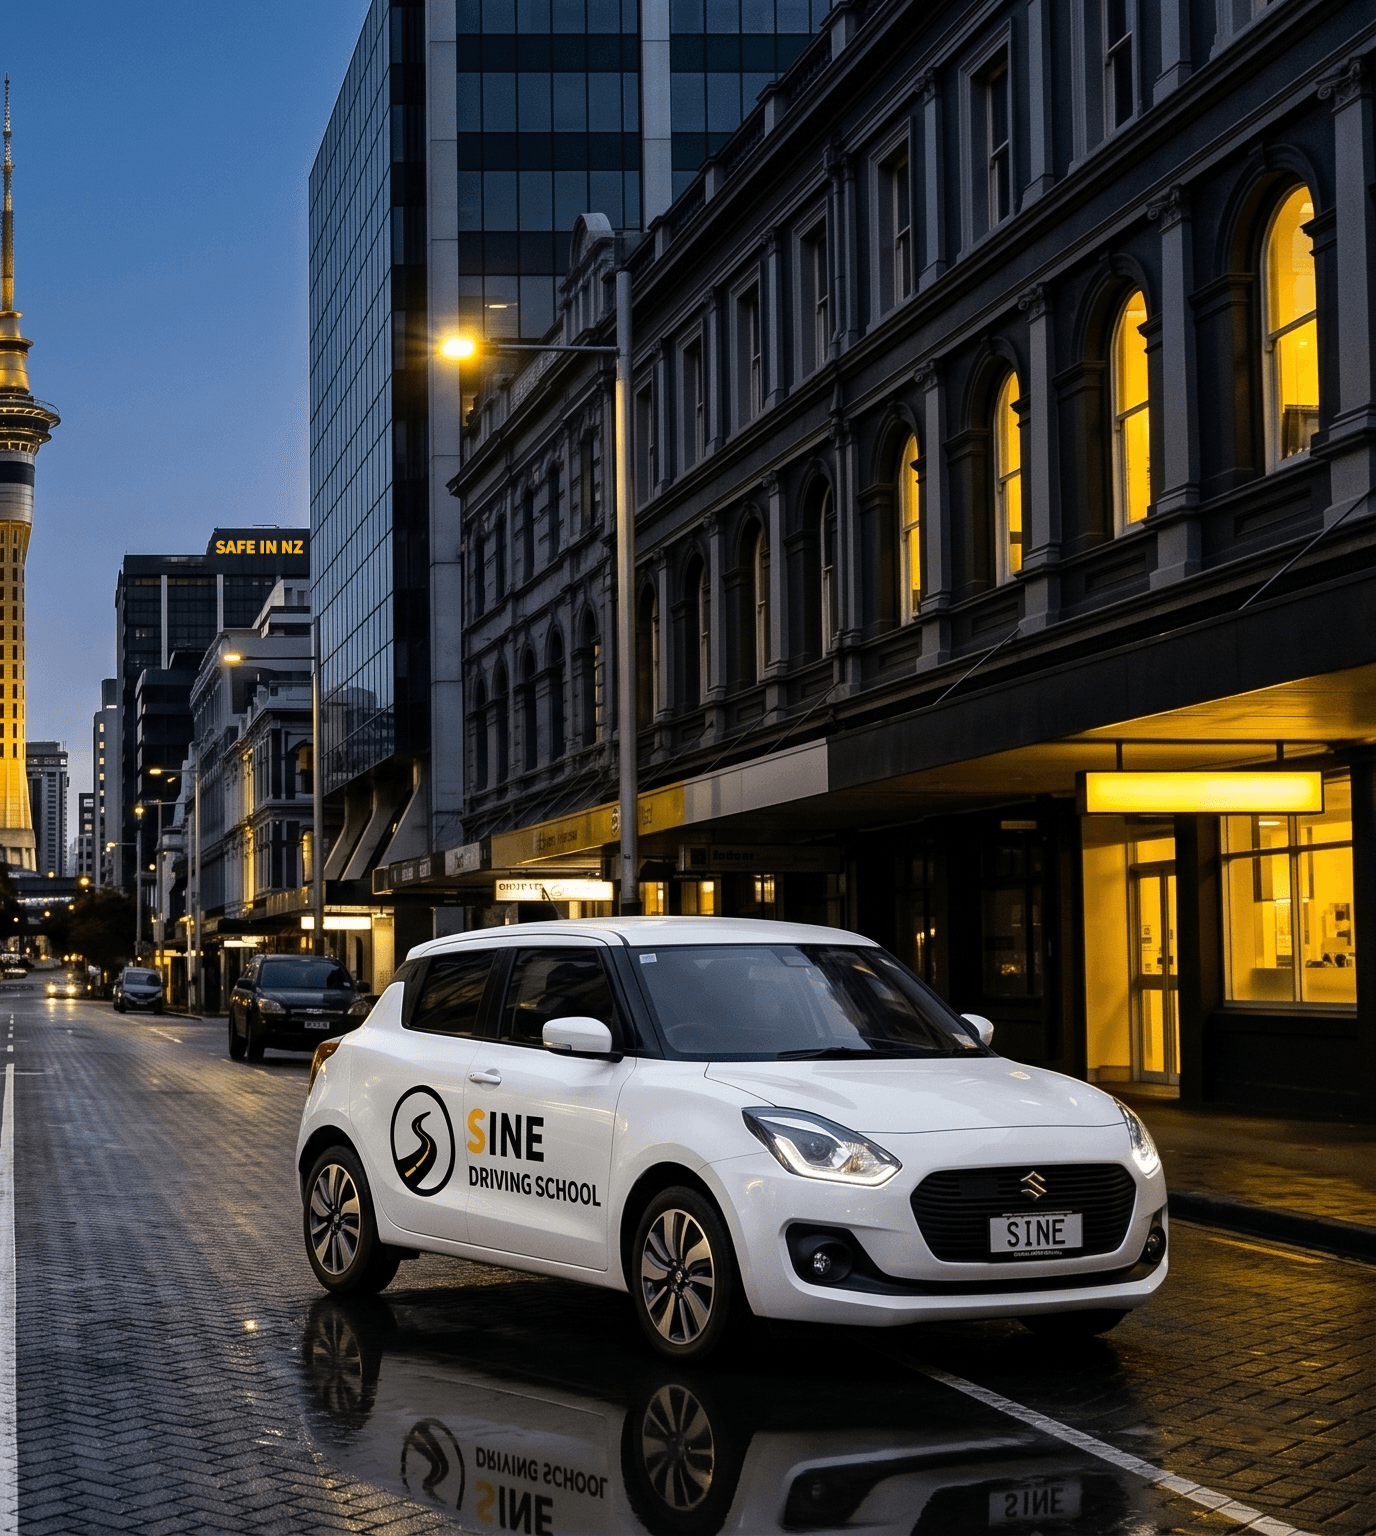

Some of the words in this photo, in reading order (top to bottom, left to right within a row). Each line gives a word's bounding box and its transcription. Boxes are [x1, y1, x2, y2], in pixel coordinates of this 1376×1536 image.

[216, 540, 256, 554] SAFE
[260, 540, 277, 554] IN
[281, 540, 304, 554] NZ
[466, 1108, 545, 1162] SINE
[468, 1165, 532, 1195] DRIVING
[535, 1175, 602, 1207] SCHOOL
[1007, 1219, 1066, 1247] SINE
